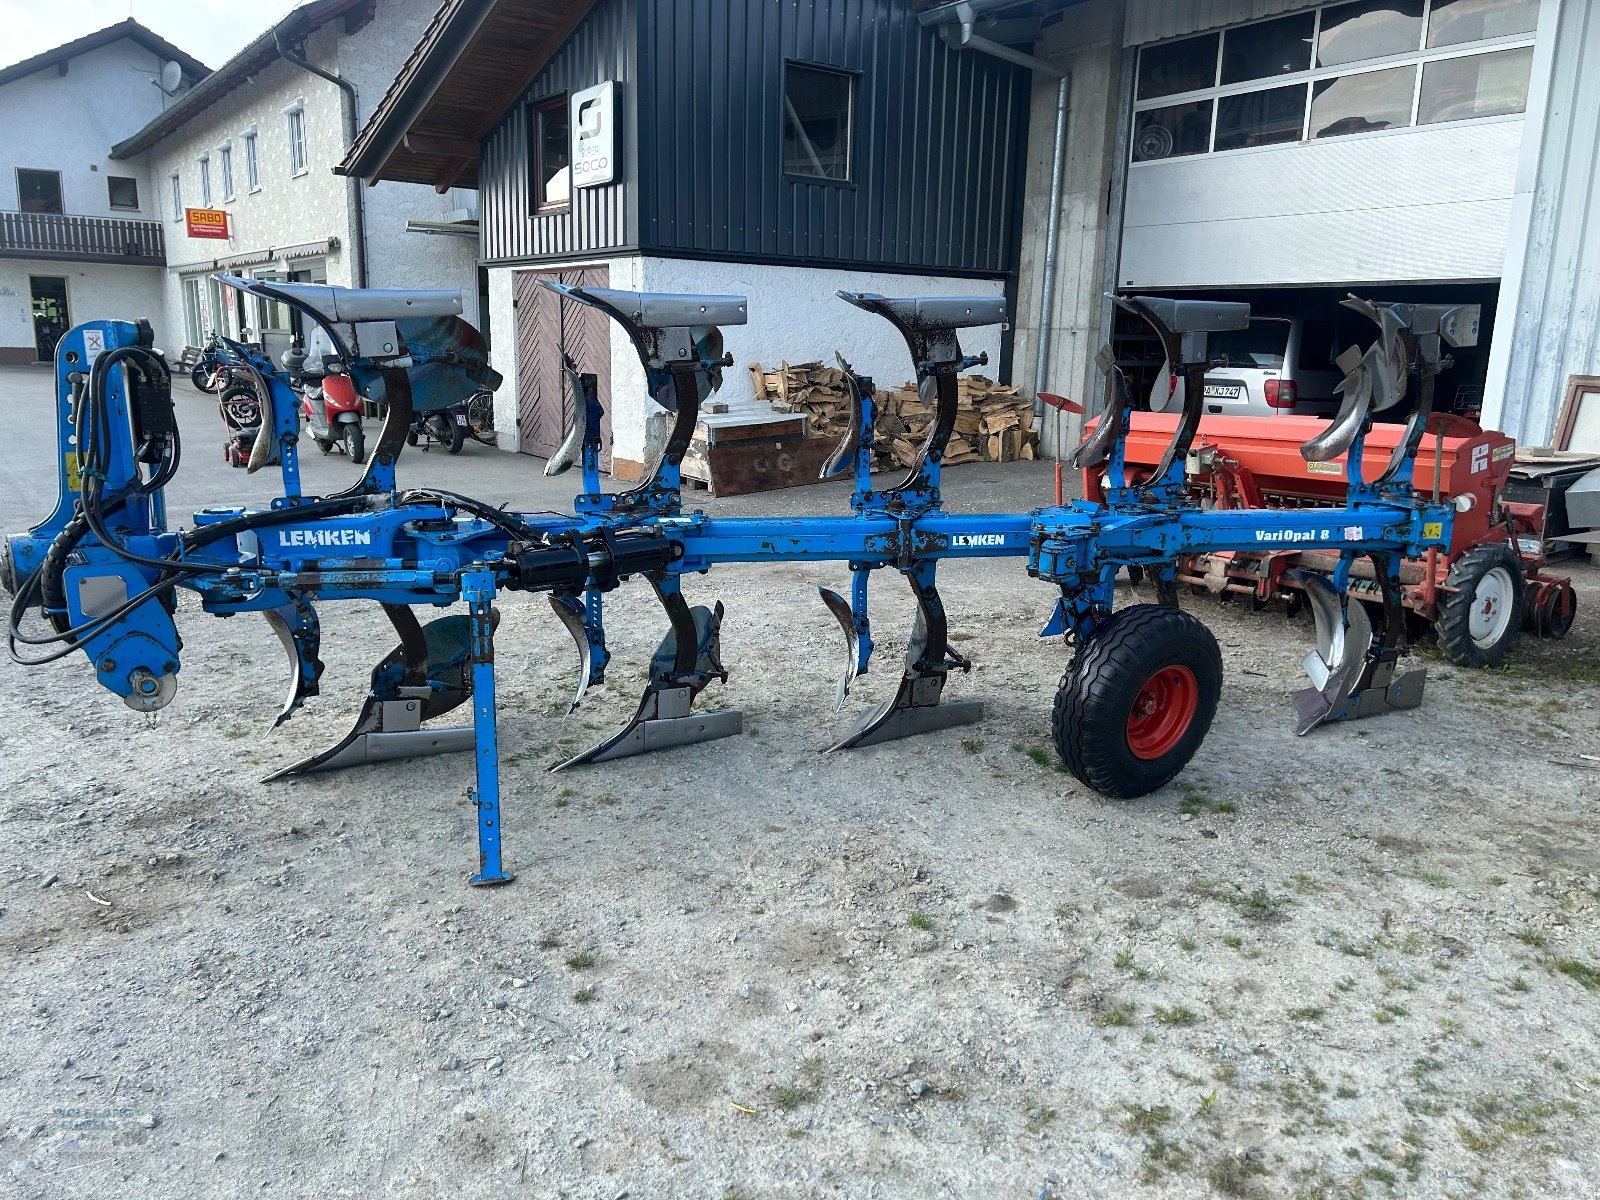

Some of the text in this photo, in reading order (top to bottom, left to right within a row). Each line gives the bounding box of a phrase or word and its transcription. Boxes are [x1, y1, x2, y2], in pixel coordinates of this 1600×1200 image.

[574, 157, 608, 174] SOCO
[192, 212, 222, 223] SABO
[279, 529, 371, 547] LEMKEN
[952, 534, 1005, 547] LEMKEN
[1255, 529, 1330, 542] VariOpal 8
